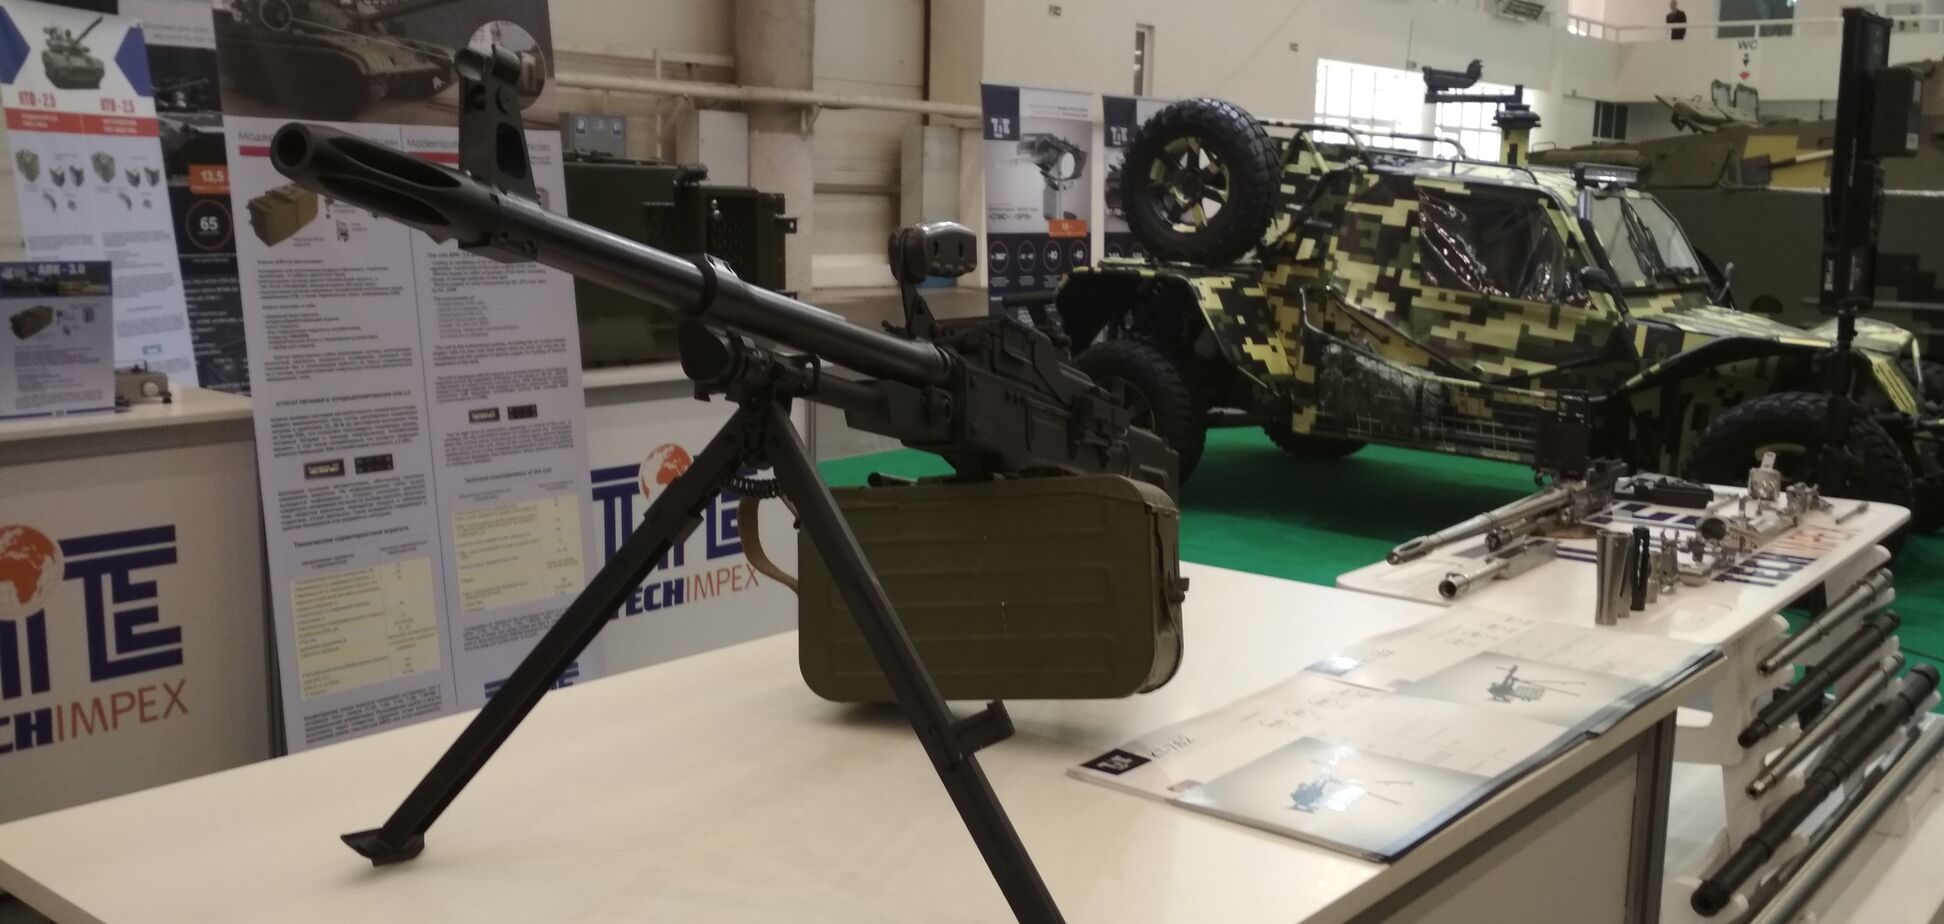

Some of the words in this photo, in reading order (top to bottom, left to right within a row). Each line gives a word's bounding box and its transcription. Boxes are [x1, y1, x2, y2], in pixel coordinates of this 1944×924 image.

[1737, 39, 1758, 50] WC
[201, 170, 224, 183] 13,5
[200, 216, 218, 230] 65
